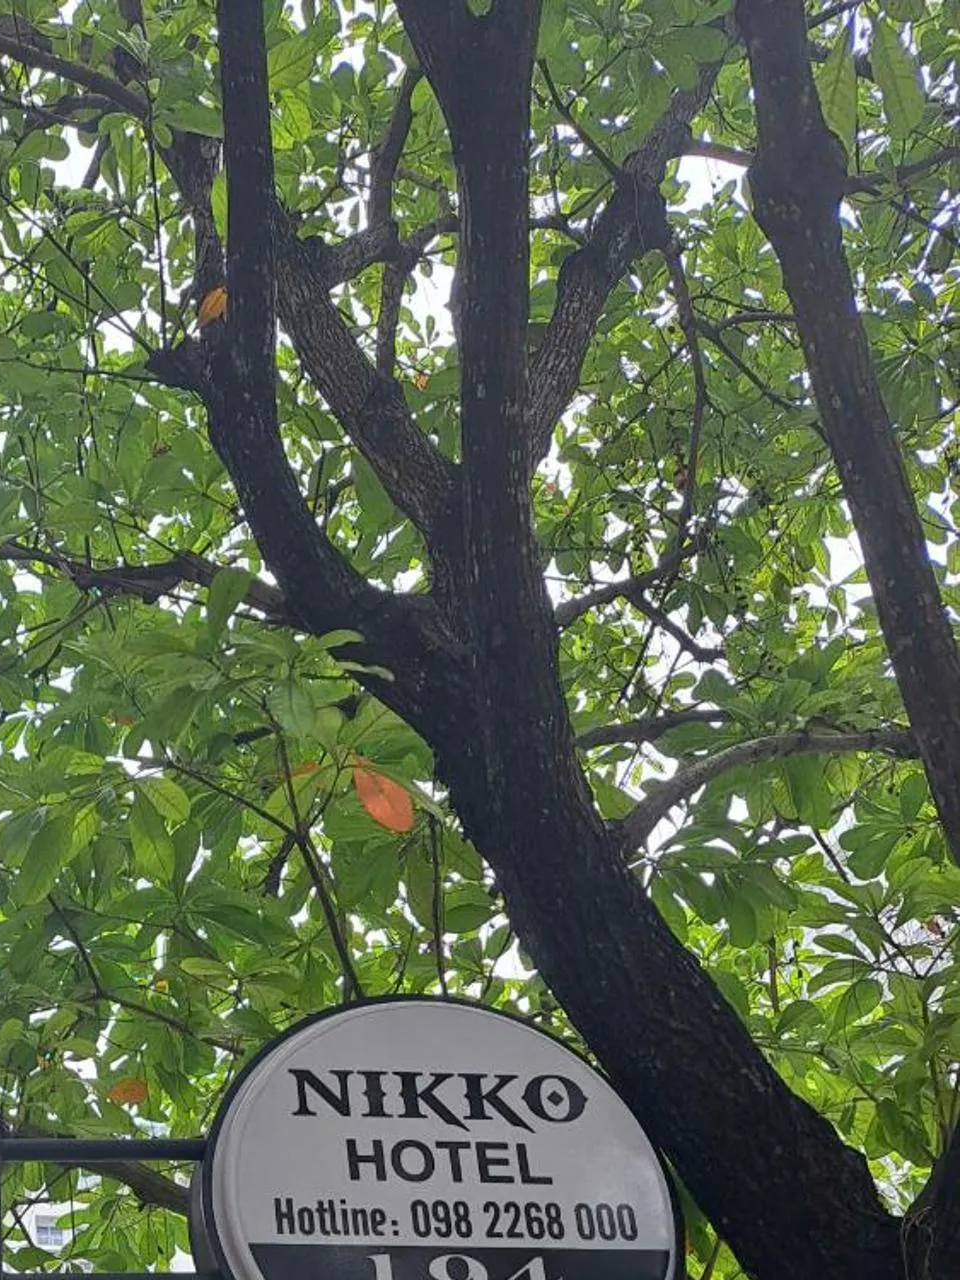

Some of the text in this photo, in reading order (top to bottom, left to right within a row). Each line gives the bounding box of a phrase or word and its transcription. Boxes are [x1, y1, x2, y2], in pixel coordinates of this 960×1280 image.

[288, 1068, 588, 1134] NIKKO
[346, 1138, 553, 1185] HOTEL
[274, 1197, 639, 1242] Hotline: 098 2268 000
